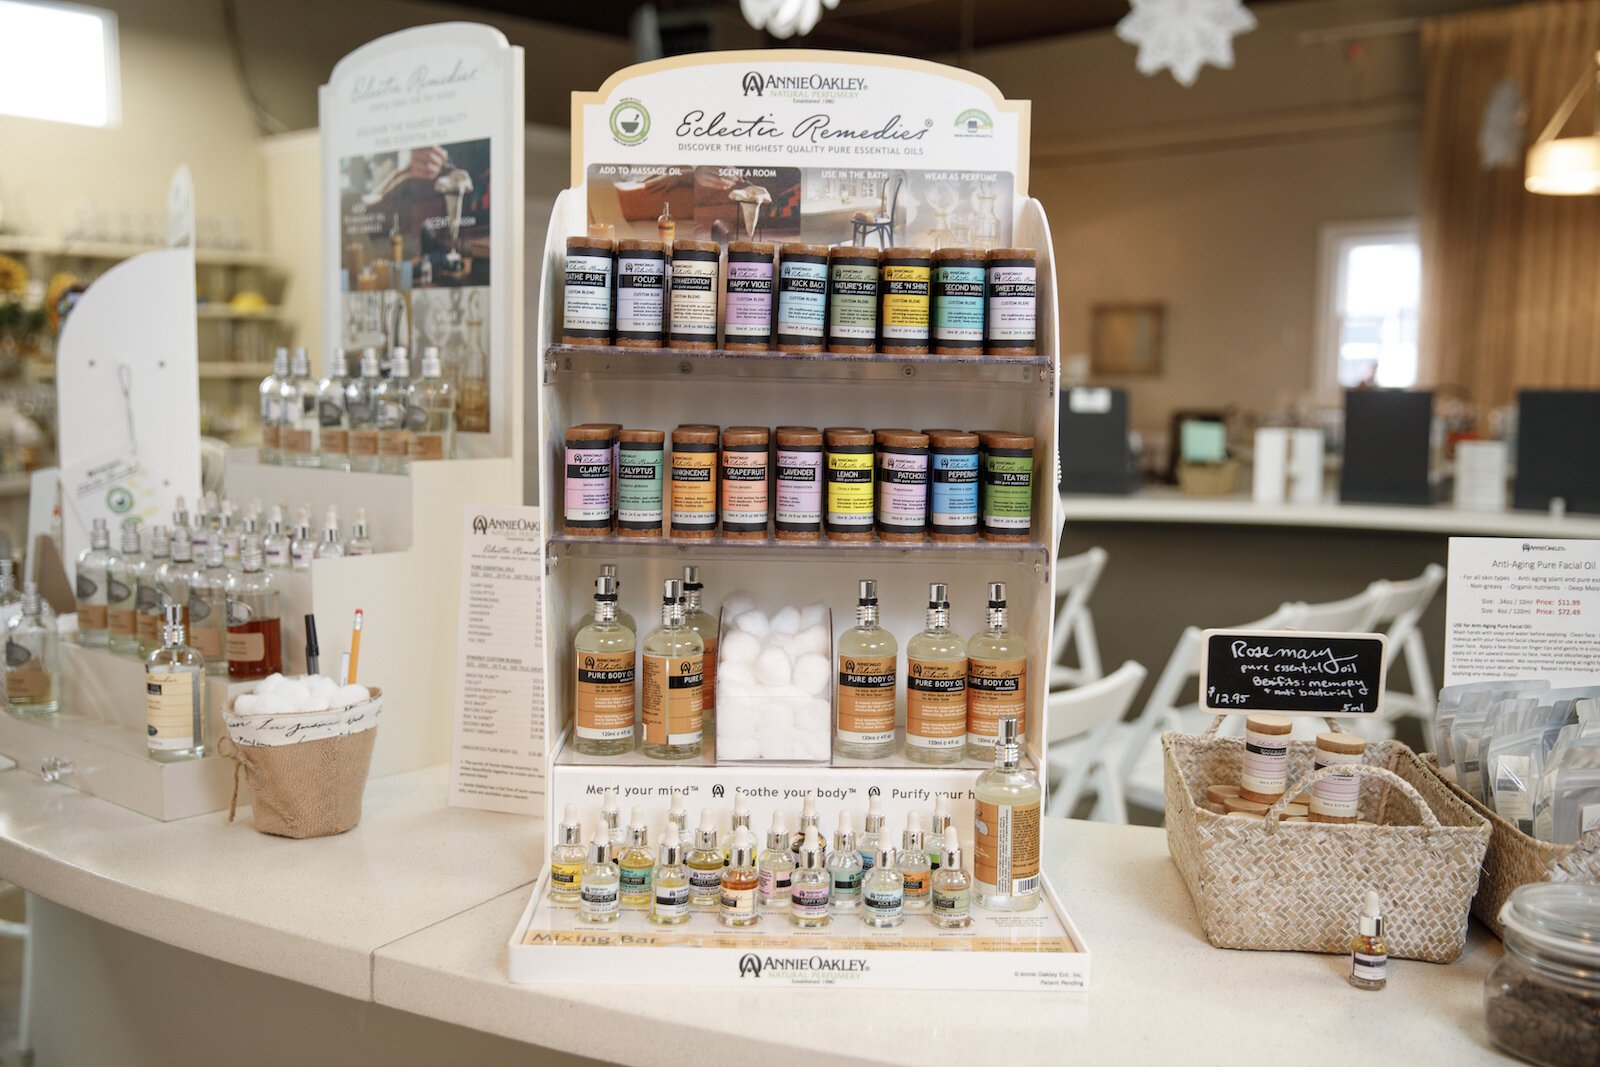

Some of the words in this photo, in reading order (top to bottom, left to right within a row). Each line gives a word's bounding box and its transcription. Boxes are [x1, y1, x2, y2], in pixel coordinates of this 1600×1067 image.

[770, 90, 808, 98] NATURAL
[812, 90, 859, 99] PERFUMERY
[675, 110, 784, 138] Eclectic
[678, 143, 721, 152] DISCOVER
[724, 144, 742, 152] THE
[745, 144, 783, 153] HIGHEST
[786, 145, 826, 154] QUALITY
[828, 146, 851, 154] PURE
[854, 146, 901, 155] ESSENTIAL
[904, 147, 924, 156] OILS
[599, 166, 616, 174] ADD
[618, 166, 629, 174] TO
[630, 167, 667, 176] MASSAGE
[668, 168, 682, 176] OIL
[718, 168, 744, 177] SCENT
[746, 169, 751, 177] A
[752, 169, 777, 177] ROOM
[822, 170, 836, 178] USE
[838, 170, 847, 179] IN
[849, 171, 864, 179] THE
[866, 171, 888, 180] BATH
[924, 172, 947, 180] WEAR
[961, 173, 998, 181] PERFUME
[585, 274, 604, 282] PURE
[837, 470, 859, 478] LEMON
[1491, 560, 1535, 570] Anti-Aging
[1537, 560, 1556, 569] Pure
[1559, 561, 1582, 569] Facial
[1584, 561, 1596, 570] Oil
[1231, 640, 1358, 674] Rosemary
[1240, 664, 1270, 673] pure
[1274, 660, 1324, 674] essential
[1340, 663, 1357, 673] oil
[588, 671, 606, 680] PURE
[608, 671, 626, 679] BODY
[684, 675, 700, 684] PURE
[915, 679, 933, 687] PURE
[935, 679, 953, 687] BODY
[983, 678, 1002, 686] BODY
[1004, 678, 1016, 686] OIL
[1308, 679, 1368, 695] memory
[1208, 686, 1250, 704] $12.95
[1299, 688, 1353, 698] bacterial
[1342, 703, 1364, 712] 5ml
[586, 784, 620, 795] Mend
[625, 787, 653, 797] your
[735, 786, 779, 797] Soothe
[784, 788, 812, 800] your
[892, 788, 930, 801] Purify
[532, 933, 610, 945] Mixing
[620, 934, 656, 944] Bar
[810, 972, 861, 980] PERFUMERY
